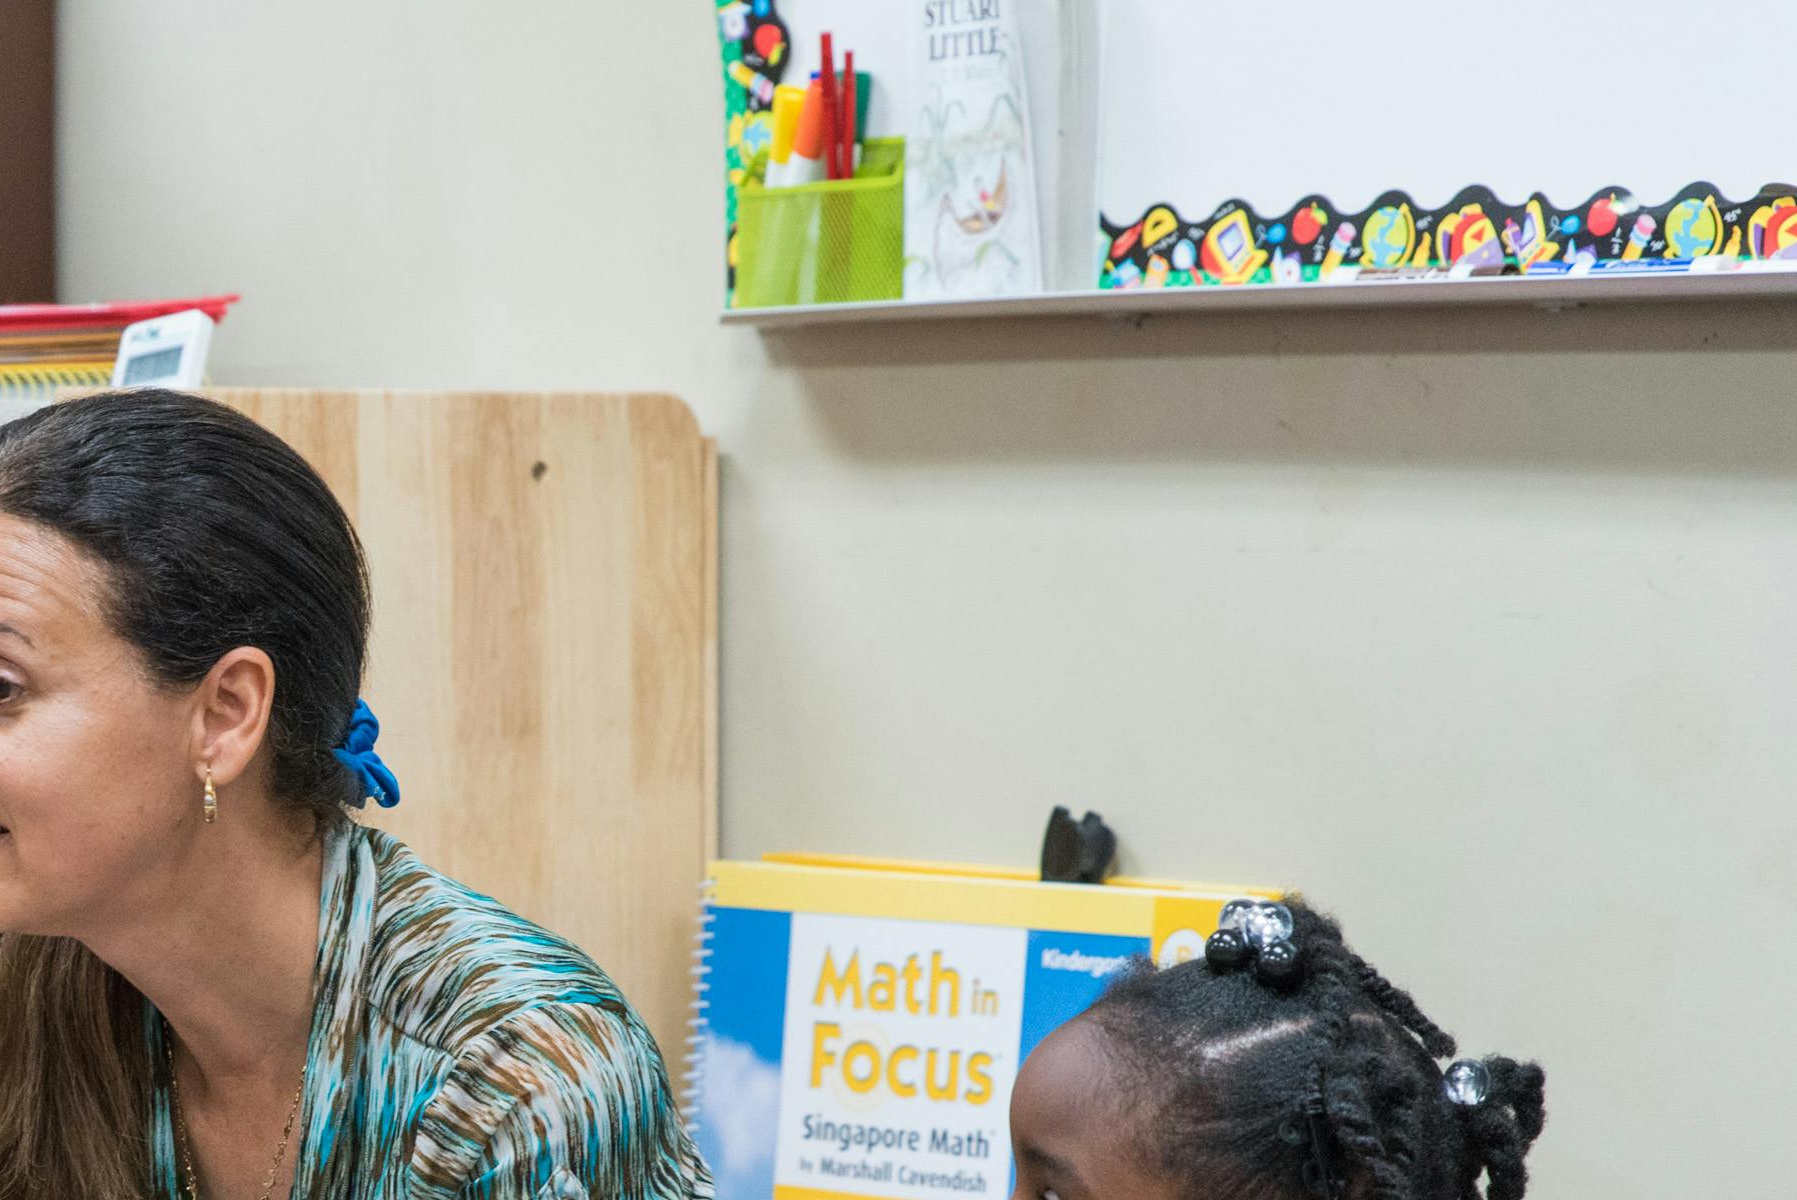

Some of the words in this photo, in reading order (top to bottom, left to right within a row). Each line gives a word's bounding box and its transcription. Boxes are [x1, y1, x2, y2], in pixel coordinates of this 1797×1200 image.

[929, 27, 1004, 60] LITTLE
[813, 946, 961, 1017] Math
[971, 977, 999, 1016] in
[810, 1021, 993, 1105] Focus
[803, 1114, 920, 1153] Singapore
[928, 1128, 989, 1158] Math
[800, 1156, 813, 1174] by
[821, 1157, 893, 1182] Marshall
[898, 1166, 987, 1193] Cavendish
